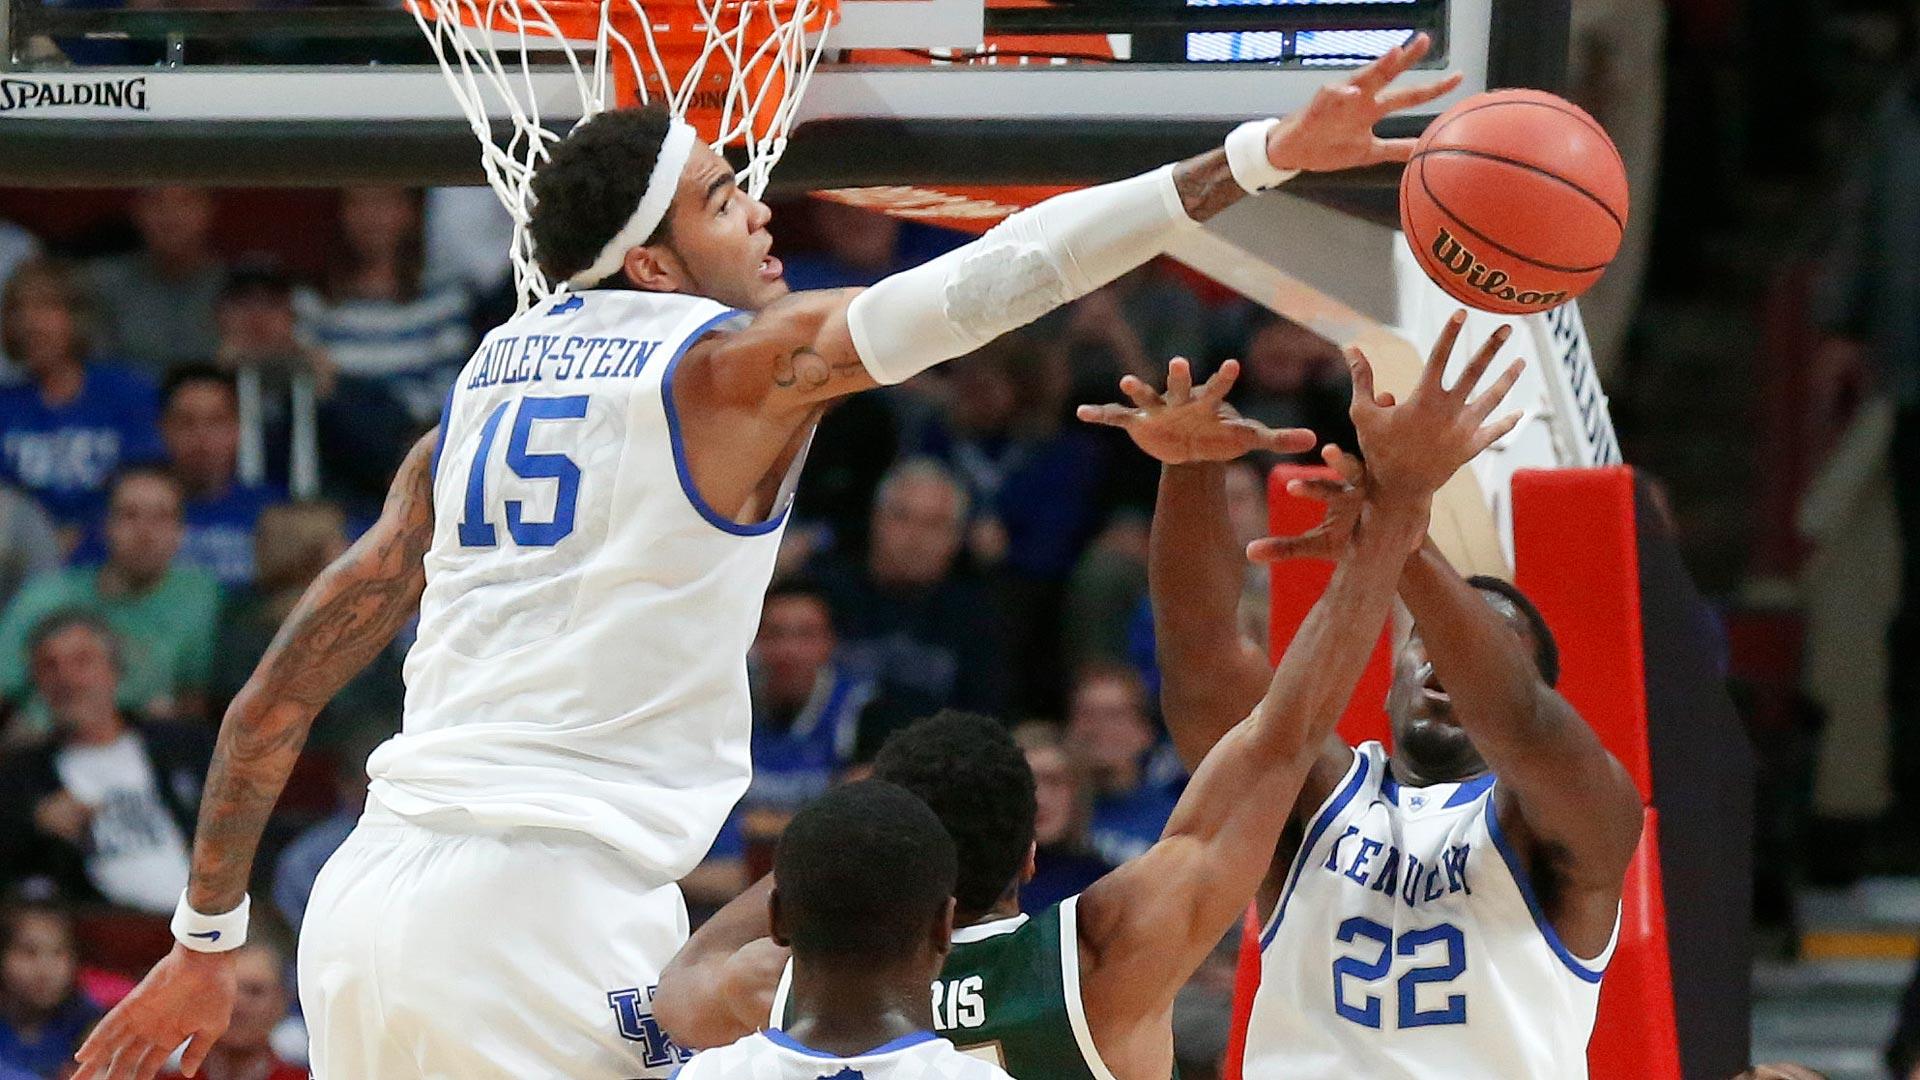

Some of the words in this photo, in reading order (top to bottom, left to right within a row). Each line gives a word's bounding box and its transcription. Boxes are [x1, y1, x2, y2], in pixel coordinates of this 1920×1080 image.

[0, 77, 147, 110] SPALDING
[1431, 227, 1568, 305] Wilson
[466, 334, 663, 390] CAULEY-STEIN
[457, 394, 590, 546] 15
[930, 974, 986, 1031] RIS
[1332, 915, 1467, 1030] 22
